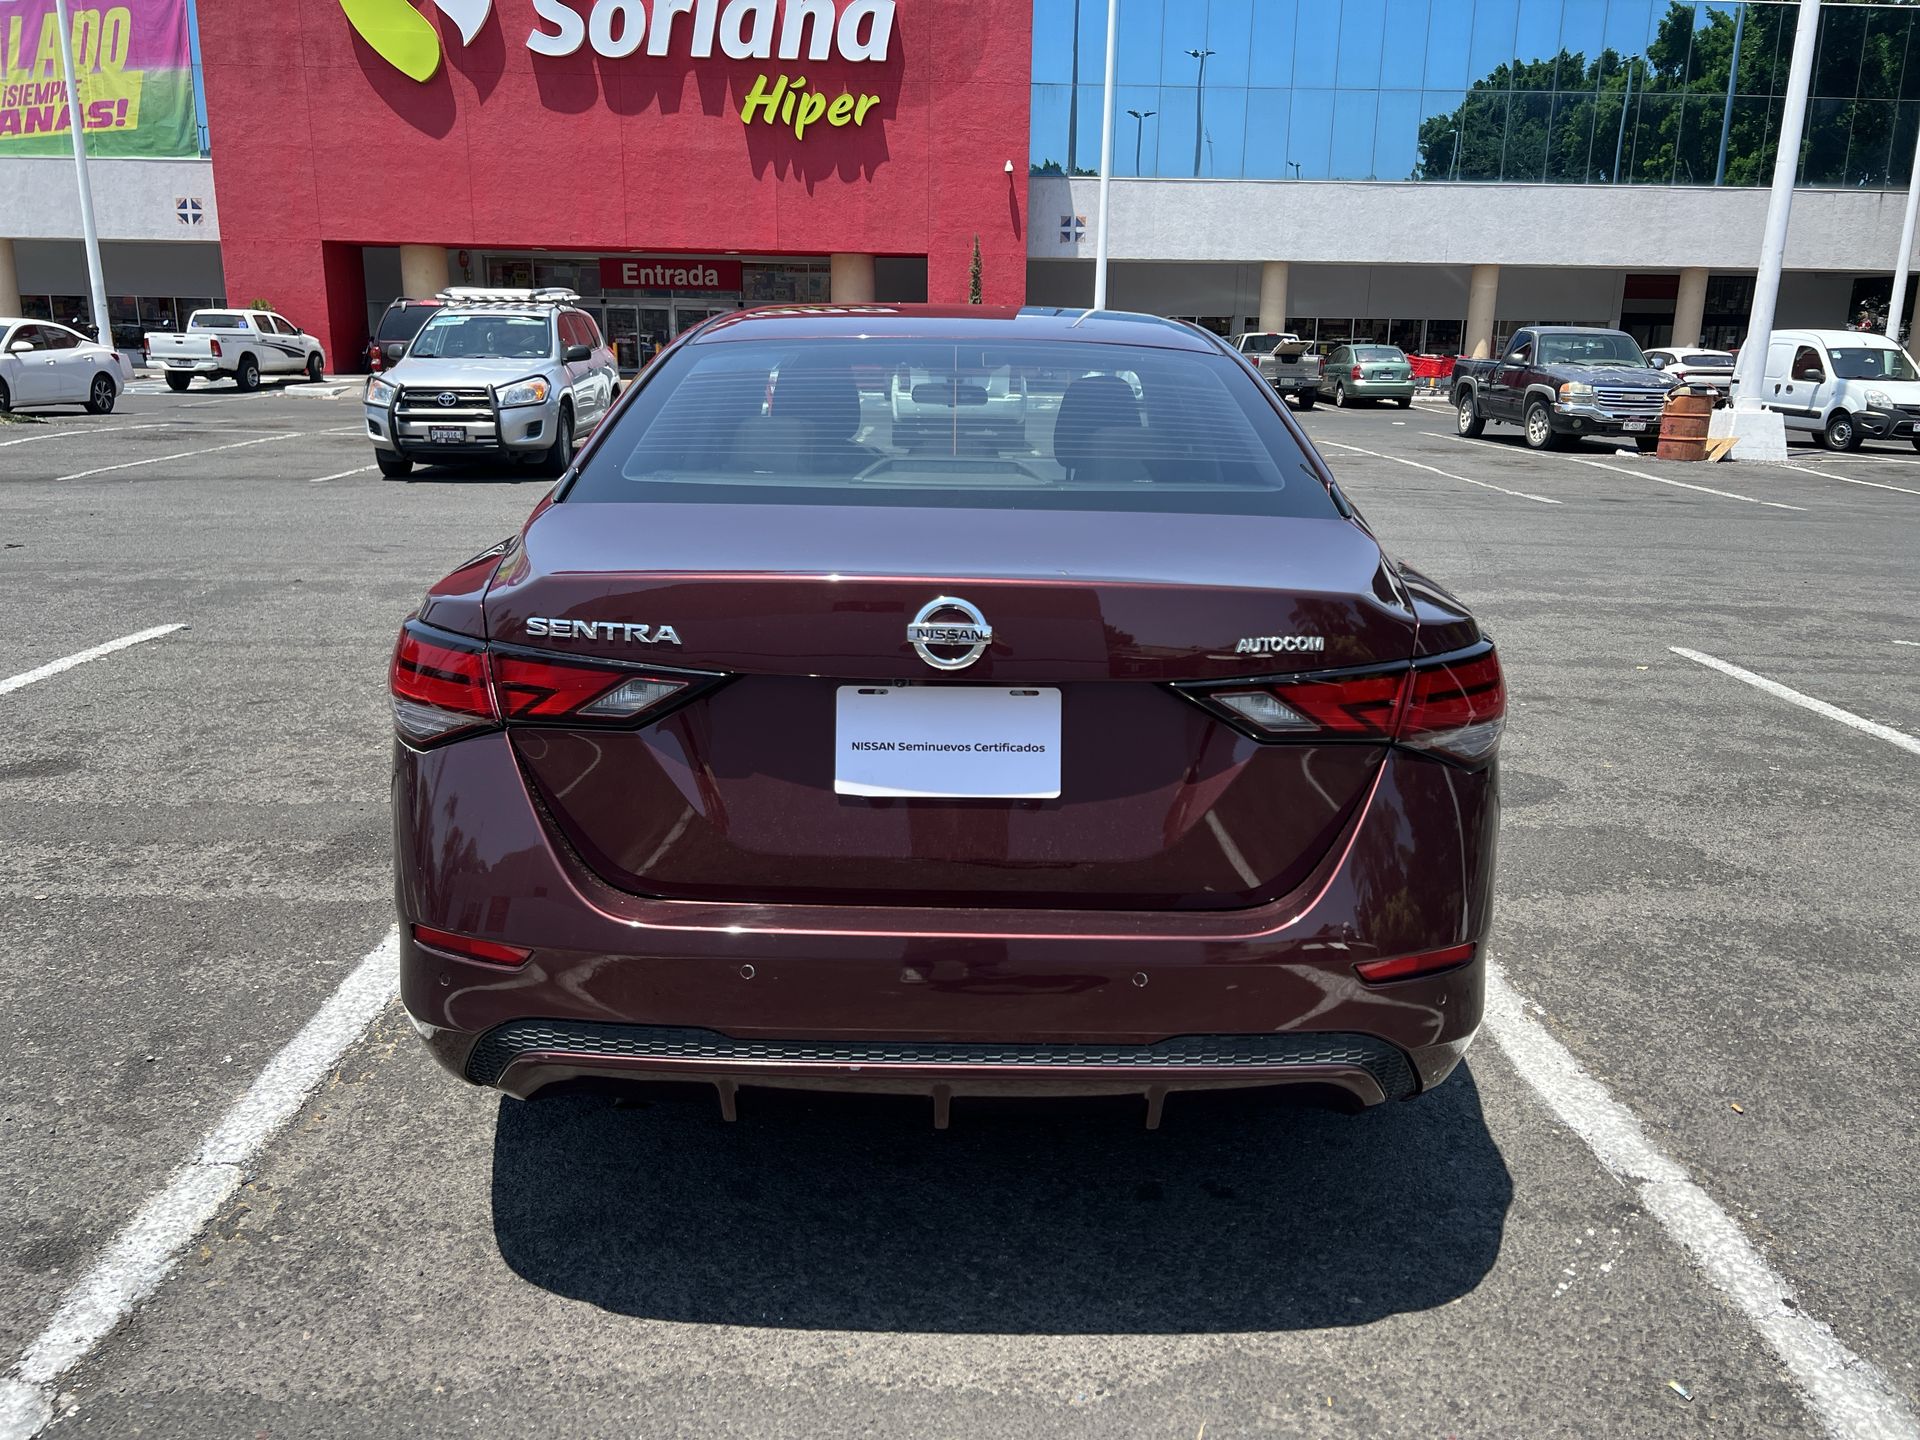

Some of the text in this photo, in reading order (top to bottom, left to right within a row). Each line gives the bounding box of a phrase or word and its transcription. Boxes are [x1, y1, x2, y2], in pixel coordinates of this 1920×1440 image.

[0, 6, 131, 80] LADO
[525, 0, 897, 62] Soriana
[740, 73, 881, 141] Híper
[622, 263, 719, 286] Entrada
[525, 616, 682, 645] SENTRA
[916, 628, 983, 641] NISSAN
[851, 741, 1046, 753] NISSAN Seminuevos Certificados
